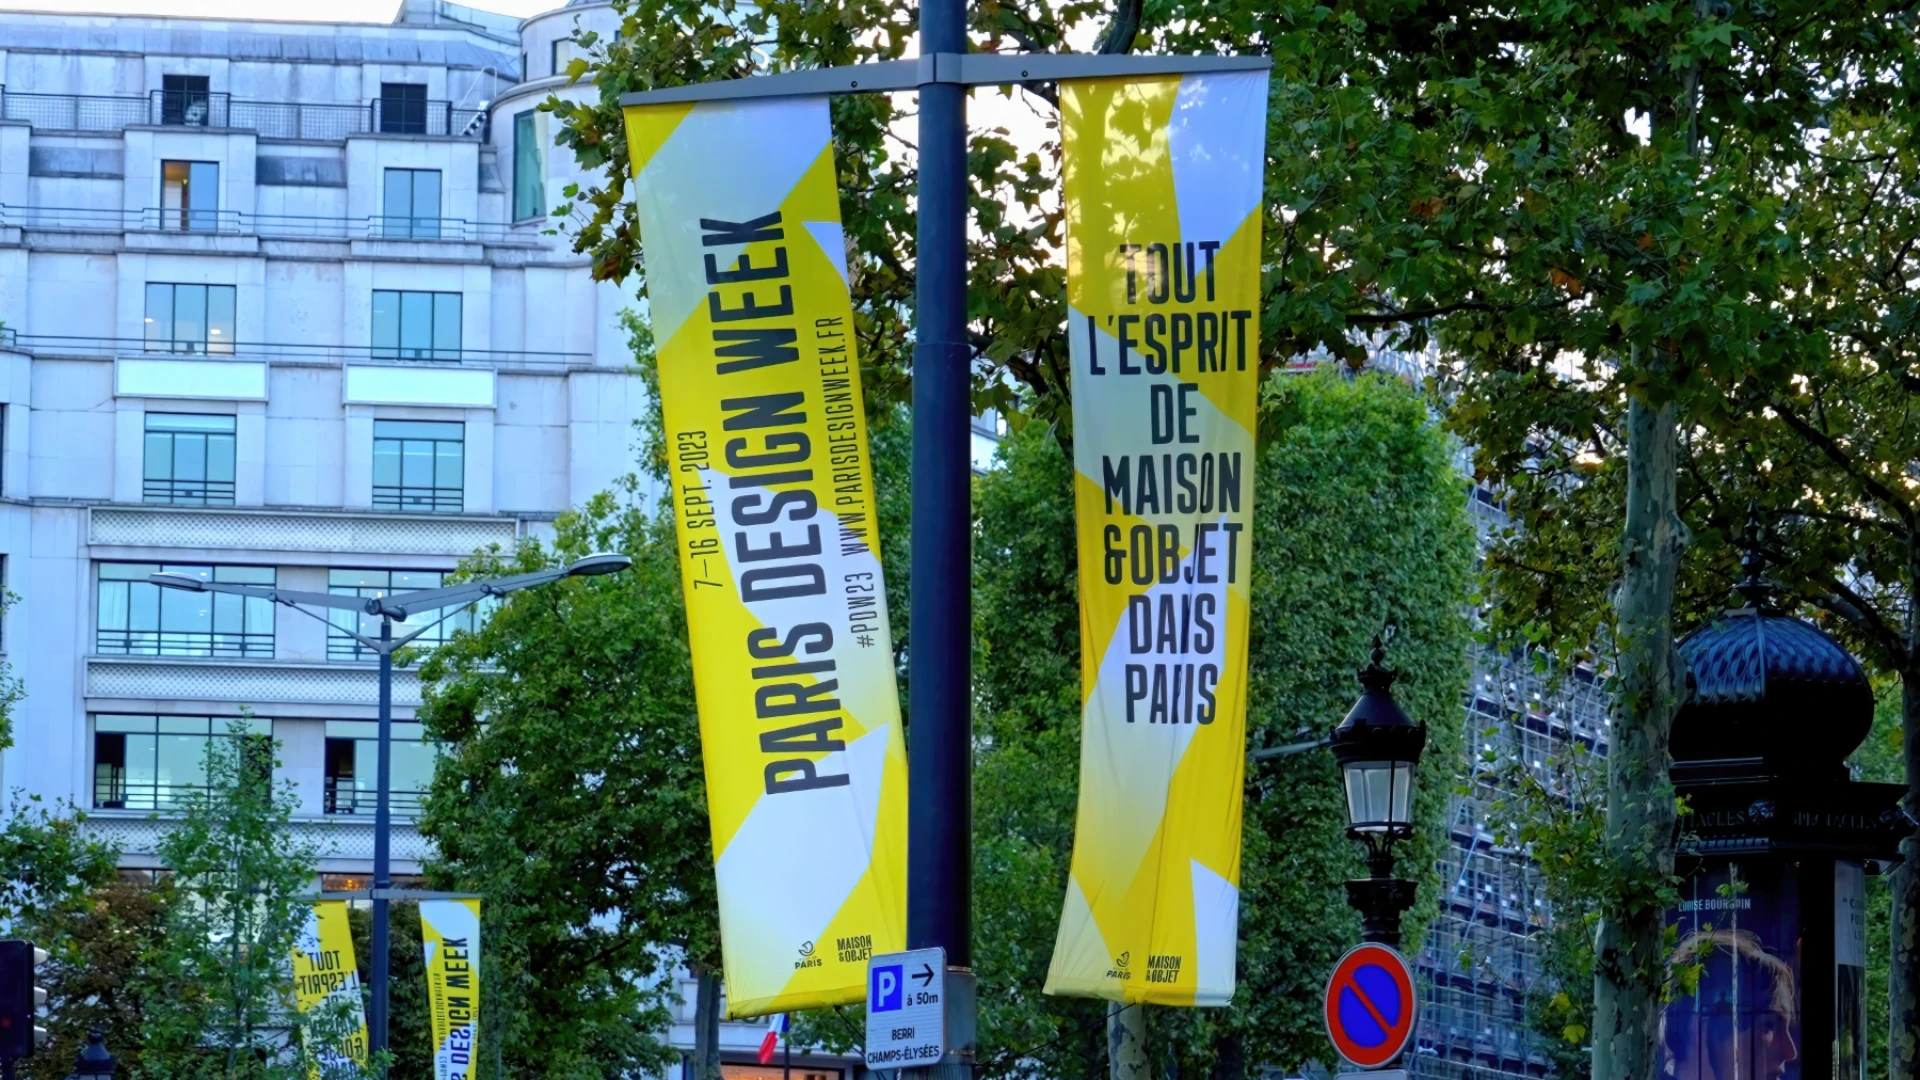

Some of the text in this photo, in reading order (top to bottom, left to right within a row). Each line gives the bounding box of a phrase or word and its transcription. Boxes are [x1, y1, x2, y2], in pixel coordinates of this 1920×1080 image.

[1119, 240, 1220, 304] TOUT
[1088, 310, 1252, 376] L'ESPRIT
[1150, 383, 1200, 445] DE
[677, 430, 710, 473] 2023
[815, 316, 879, 648] #PDW23 WWW.PARISDESIGNWEEK.FR
[1102, 452, 1242, 516] MAISON
[683, 479, 717, 529] SEPT.
[700, 211, 850, 795] PARIS DESIGN WEEK
[1103, 523, 1243, 586] &OBJET
[836, 934, 873, 951] MAISON
[838, 947, 873, 963] &OBJET
[794, 958, 823, 970] PARIS
[1106, 970, 1131, 980] PARIS
[1145, 969, 1180, 983] &OBJET
[1147, 955, 1182, 970] MAISON
[878, 971, 896, 1007] P
[907, 992, 939, 1006] à 50m
[891, 1027, 915, 1041] BERRI
[867, 1044, 940, 1065] CHAMPS-ÉLYSÉES
